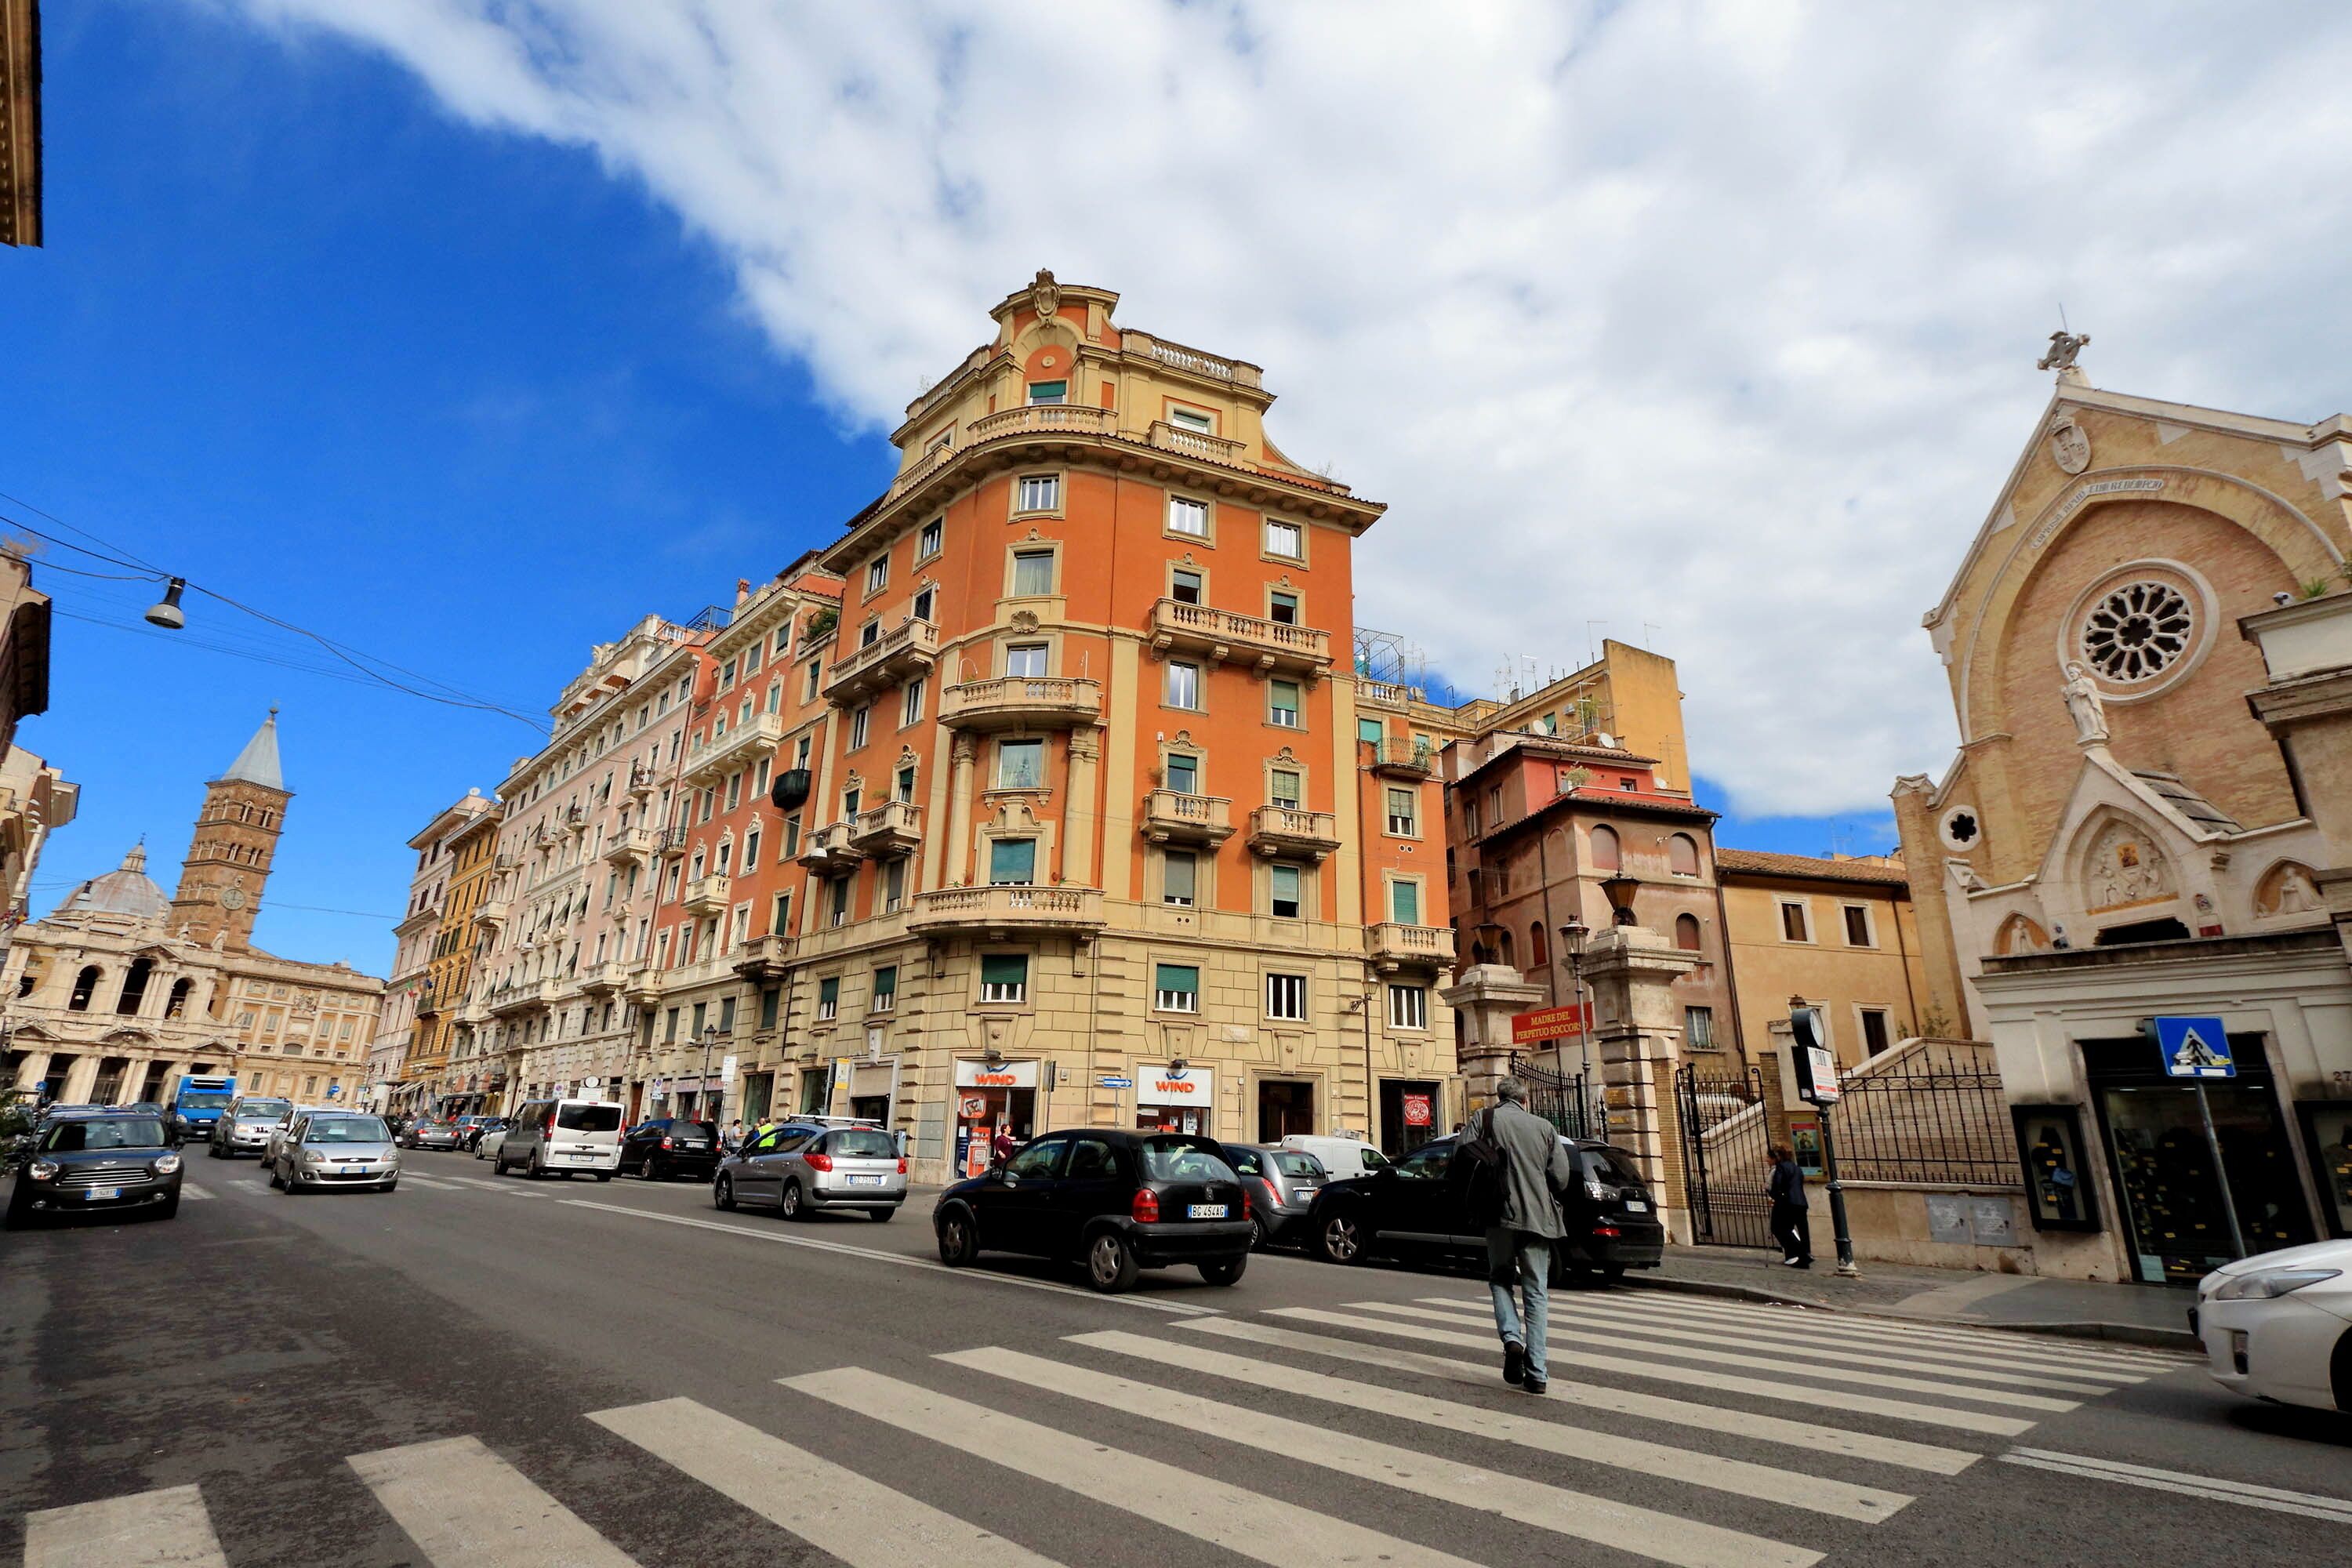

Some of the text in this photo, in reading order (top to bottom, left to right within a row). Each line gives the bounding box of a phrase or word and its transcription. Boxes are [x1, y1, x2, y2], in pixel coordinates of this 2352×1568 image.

[1531, 1011, 1570, 1025] MADRE DEL
[1516, 1027, 1549, 1040] PERPETUO
[975, 1073, 1017, 1086] WIND
[1156, 1080, 1196, 1093] WIND
